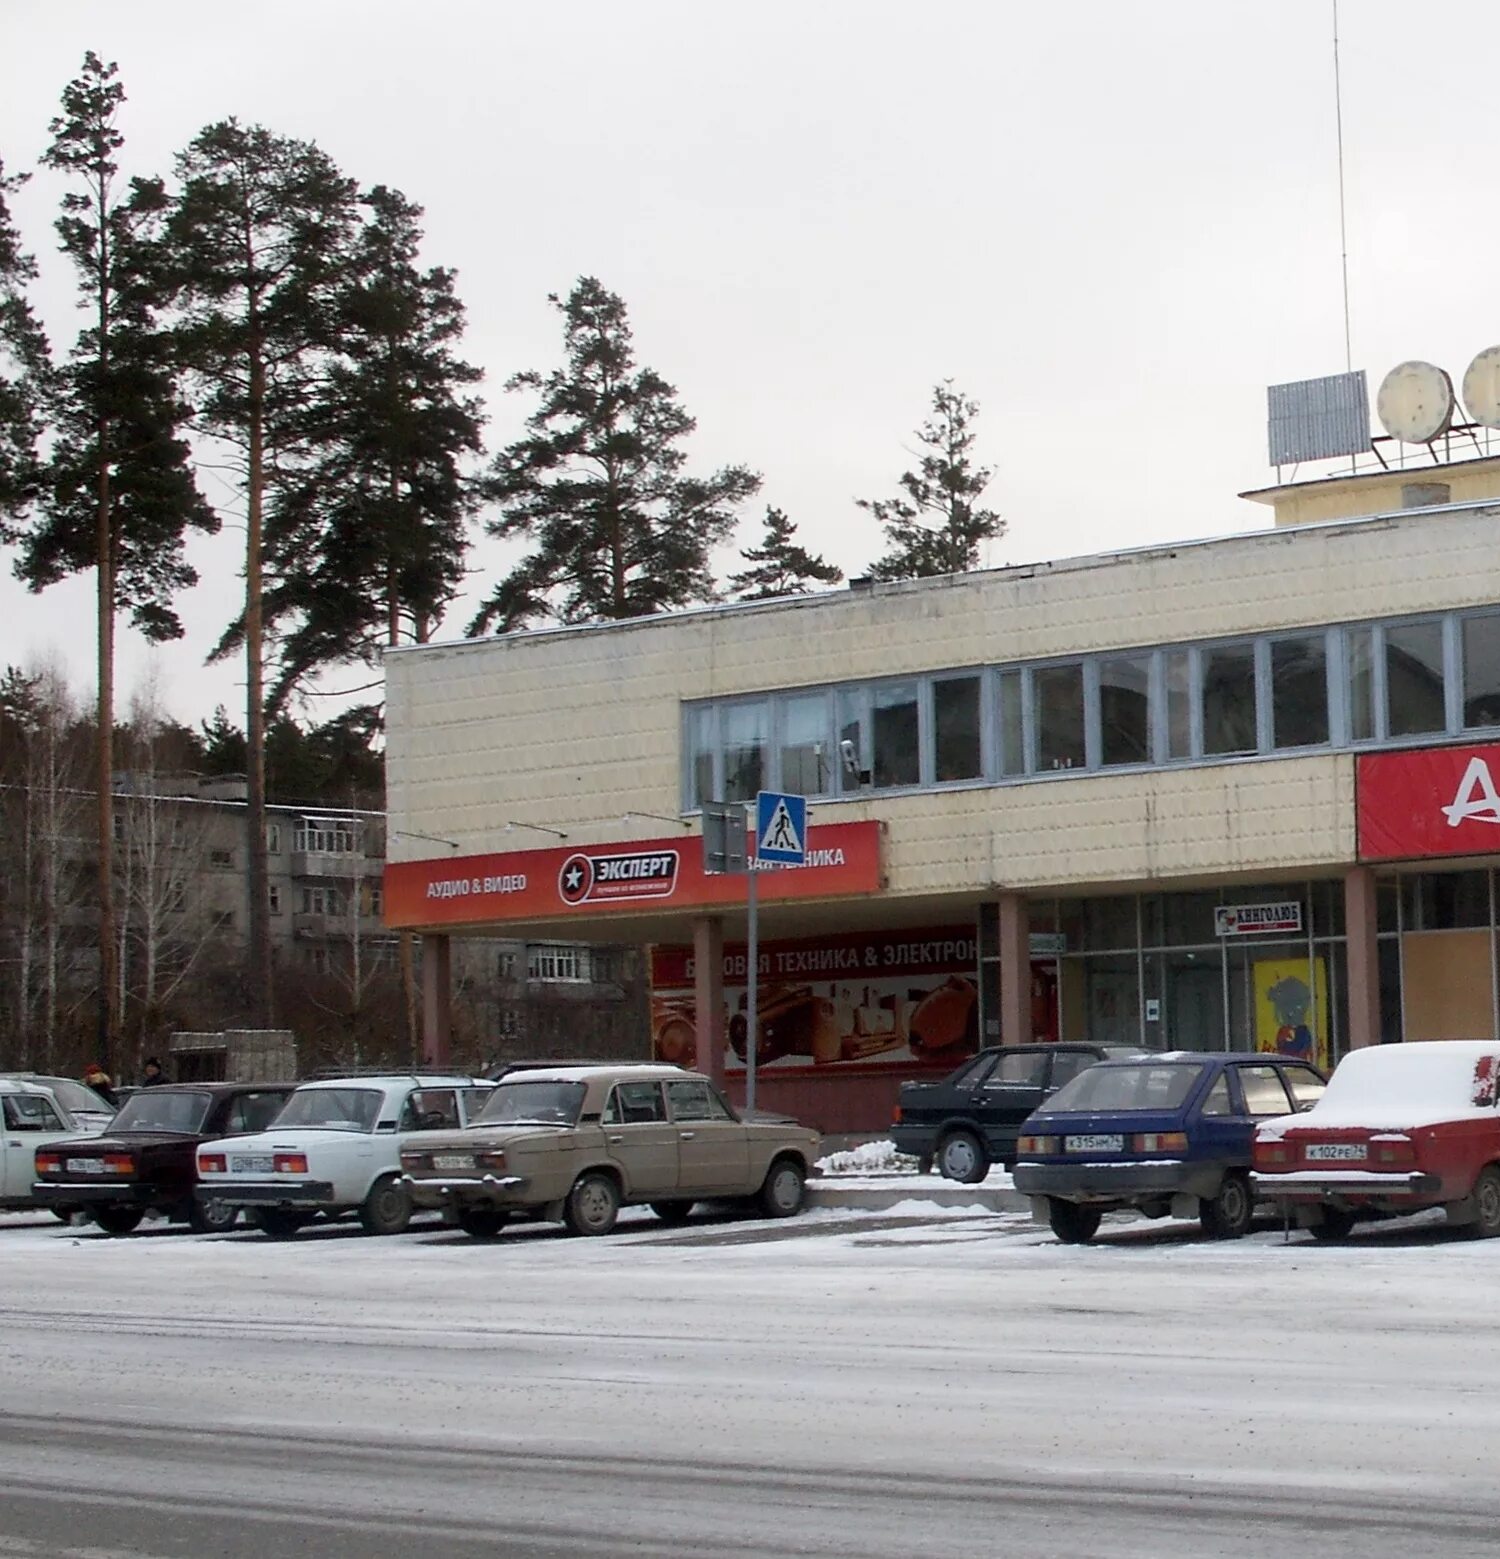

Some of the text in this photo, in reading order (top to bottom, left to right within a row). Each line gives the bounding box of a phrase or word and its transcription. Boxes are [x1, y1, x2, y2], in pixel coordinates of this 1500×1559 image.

[597, 857, 672, 880] ЭКСПЕРТ
[427, 874, 527, 899] АУДИО & ВИДЕО
[1236, 905, 1298, 923] КНИГОЛЮБ
[685, 953, 770, 978] БОВЯ
[775, 948, 860, 973] ТЕХНИКА
[864, 946, 878, 966] &
